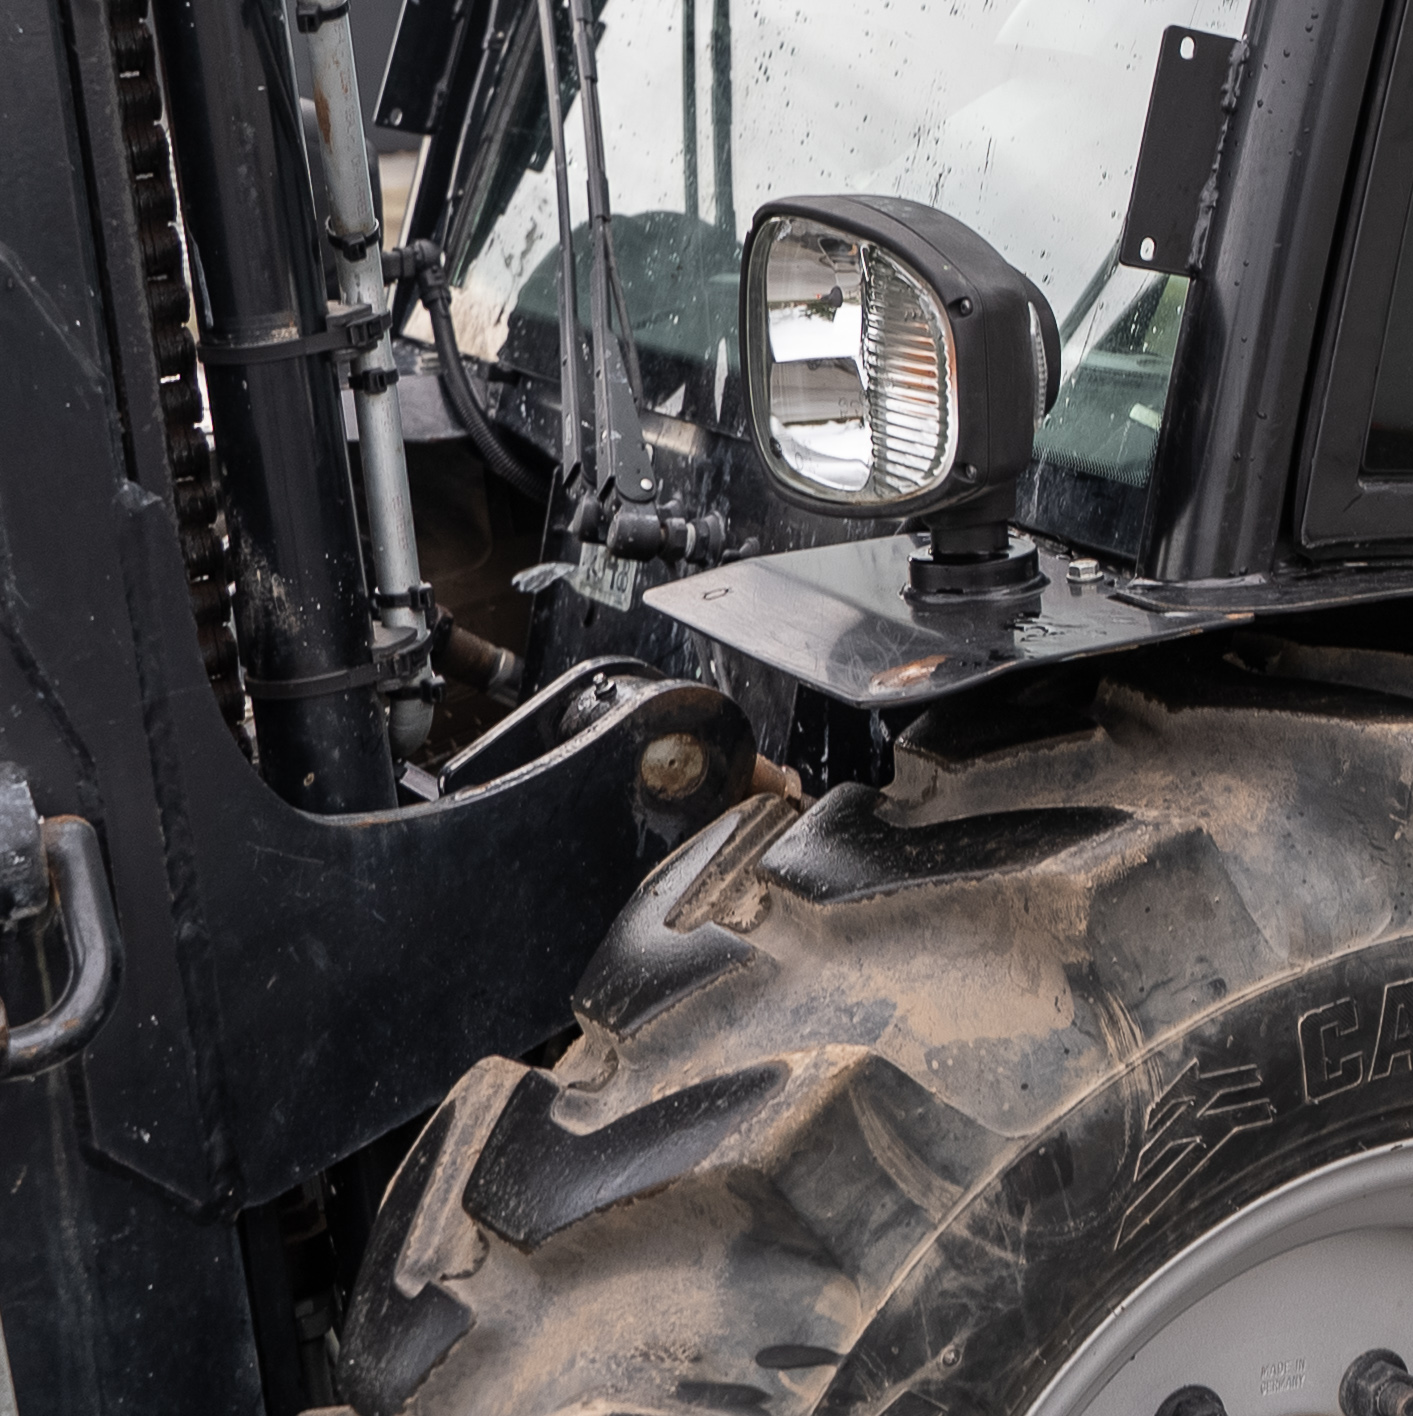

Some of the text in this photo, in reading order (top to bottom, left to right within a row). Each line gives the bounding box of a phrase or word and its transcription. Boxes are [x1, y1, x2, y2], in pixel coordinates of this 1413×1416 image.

[1261, 1357, 1306, 1380] MADE IN
[1261, 1374, 1306, 1396] GERMANY
